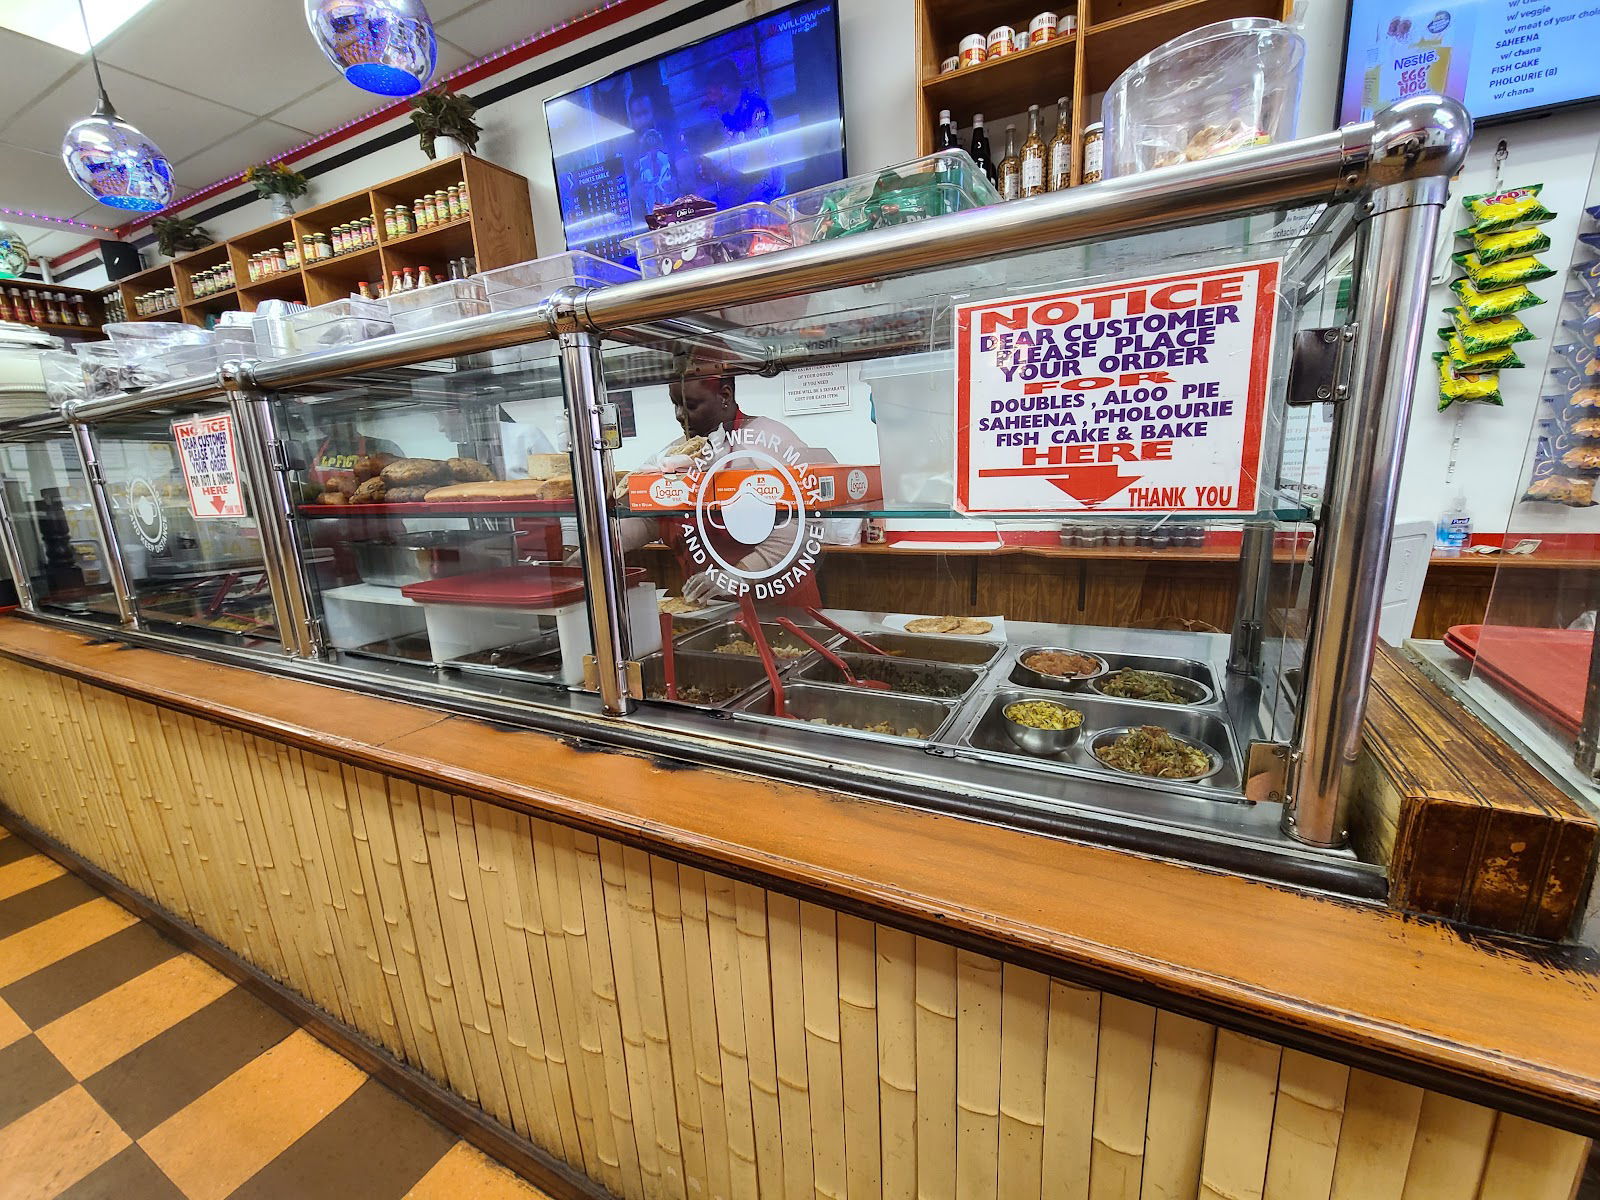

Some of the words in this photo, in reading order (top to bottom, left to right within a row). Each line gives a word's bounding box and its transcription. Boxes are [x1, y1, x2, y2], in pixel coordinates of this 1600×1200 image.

[1520, 5, 1551, 18] veggie
[1518, 21, 1542, 32] meat
[1544, 17, 1553, 26] of
[1555, 14, 1576, 26] your
[1495, 33, 1539, 49] SAHEENA
[1514, 46, 1542, 57] chana
[1401, 66, 1426, 83] EGG
[1491, 64, 1512, 74] FISH
[1514, 58, 1539, 70] CAKE
[1398, 79, 1427, 96] NOG
[1489, 71, 1543, 88] PHOLOURIE
[1507, 87, 1534, 97] chana
[980, 276, 1244, 334] NOTICE
[980, 328, 1054, 352] DEAR
[1063, 304, 1240, 342] CUSTOMER
[996, 341, 1097, 368] PLEASE
[1114, 326, 1216, 354] PLACE
[1000, 360, 1082, 382] YOUR
[1098, 346, 1208, 373] ORDER
[1024, 371, 1177, 395] FOR
[1103, 387, 1168, 406] ALOO
[1182, 381, 1220, 400] PIE
[978, 412, 1077, 432] SAHEENA
[1094, 400, 1234, 424] PHOLOURIE
[182, 436, 198, 450] DEAR
[198, 431, 227, 448] CUSTOMER
[996, 432, 1039, 447] FISH
[1051, 428, 1110, 444] CAKE
[1116, 426, 1133, 441] &
[1141, 421, 1208, 440] BAKE
[189, 448, 208, 462] PLEASE
[210, 445, 226, 458] PLACE
[1022, 441, 1174, 466] HERE
[192, 461, 208, 474] YOUR
[210, 458, 228, 472] ORDER
[725, 428, 782, 452] WEAR
[783, 445, 823, 506] MASK
[202, 486, 228, 496] HERE
[1128, 486, 1187, 507] THANK
[1196, 485, 1232, 507] YOU
[682, 524, 706, 565] AND
[705, 564, 750, 598] KEEP
[755, 525, 825, 600] DISTANCE
